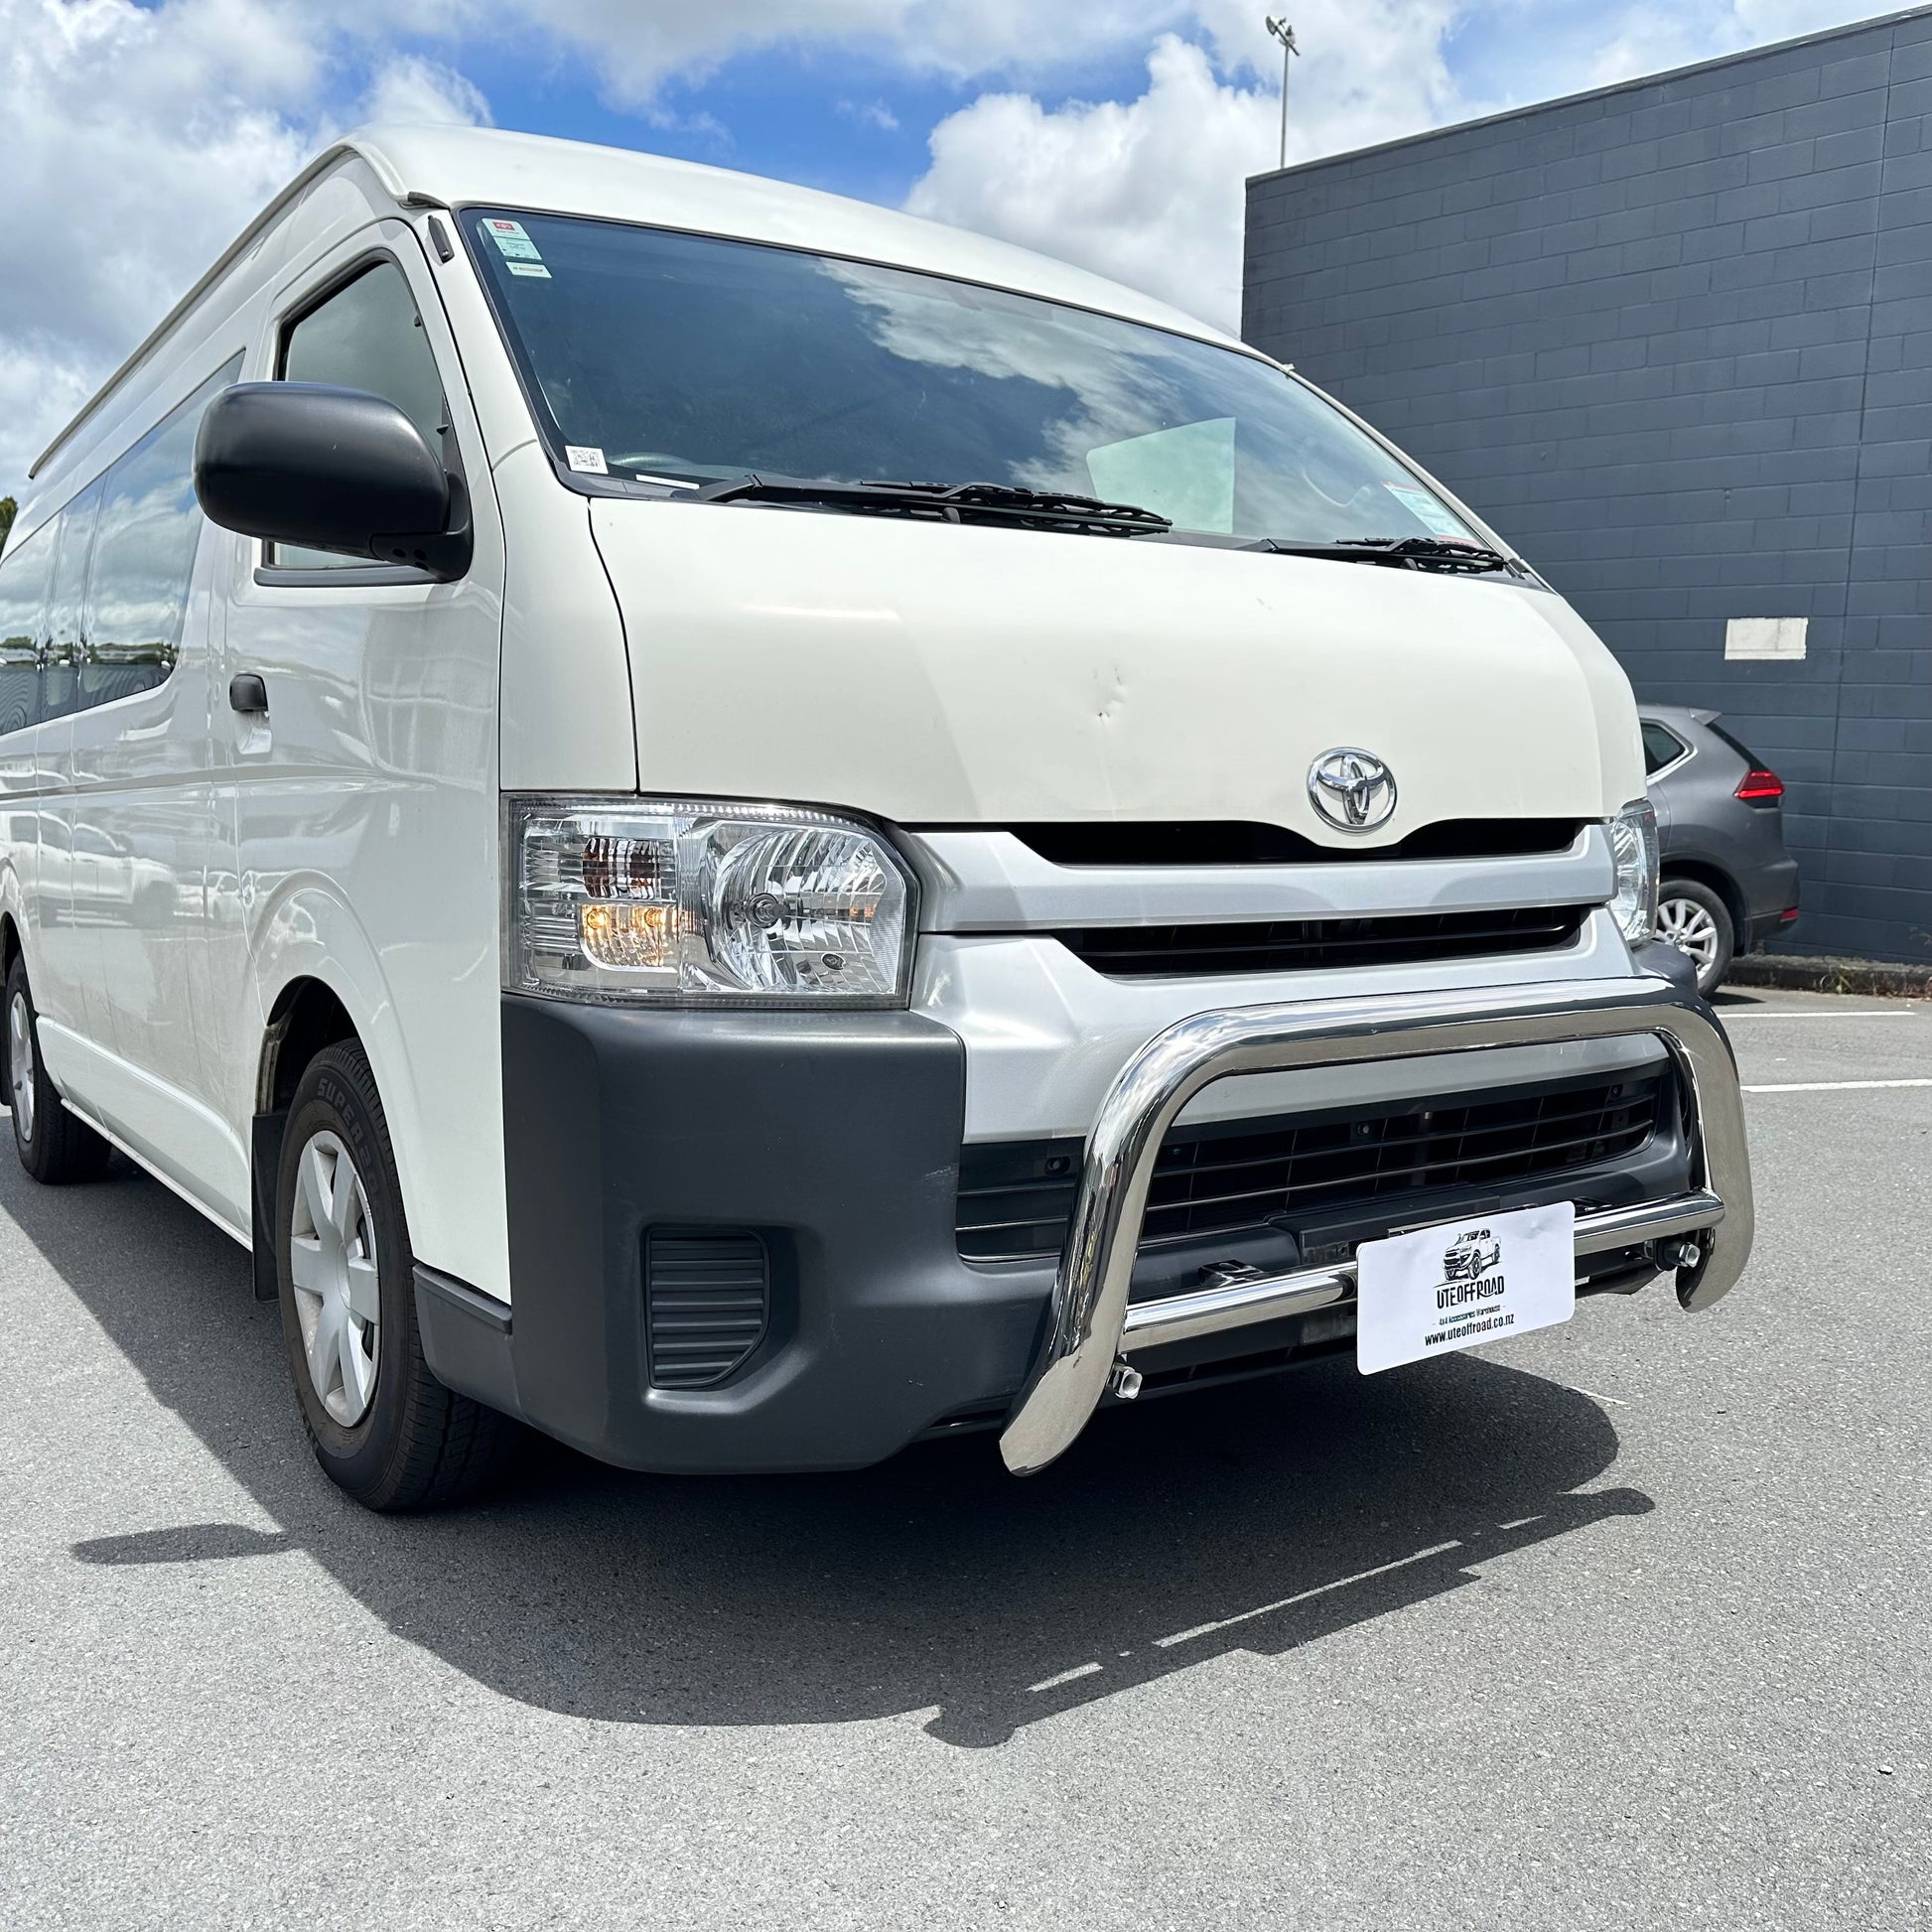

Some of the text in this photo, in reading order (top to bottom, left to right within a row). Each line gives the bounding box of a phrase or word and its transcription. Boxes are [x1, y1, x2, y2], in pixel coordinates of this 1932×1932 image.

[1437, 1276, 1504, 1309] UTEOFFROAD
[1425, 1314, 1514, 1345] www.uteoffroad.co.nz
[1449, 1311, 1476, 1323] Accessories
